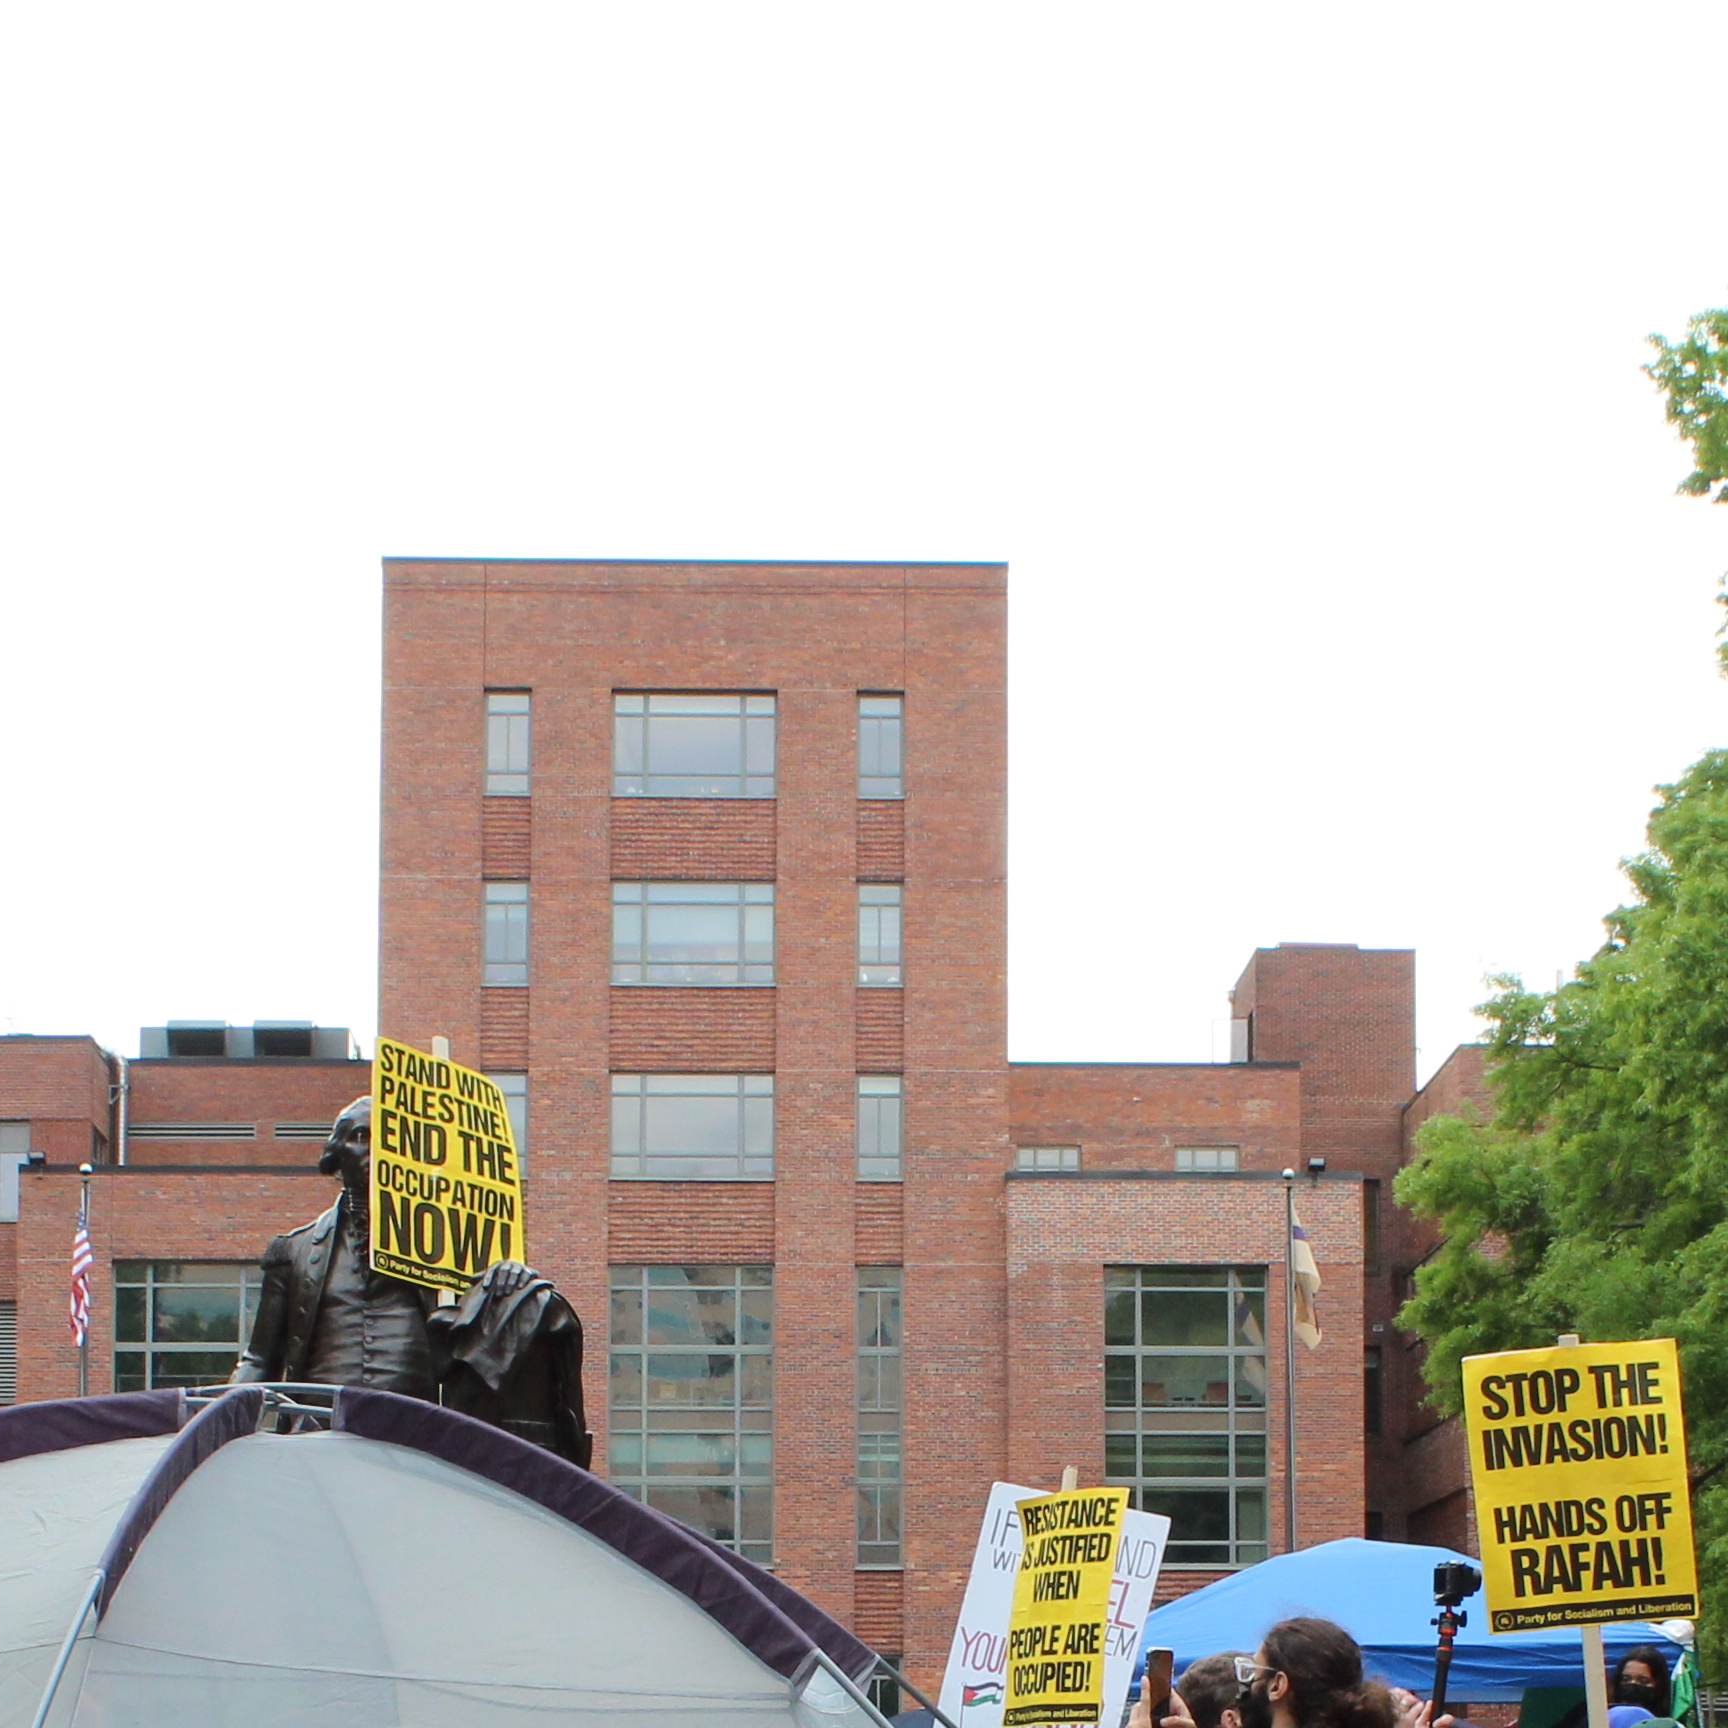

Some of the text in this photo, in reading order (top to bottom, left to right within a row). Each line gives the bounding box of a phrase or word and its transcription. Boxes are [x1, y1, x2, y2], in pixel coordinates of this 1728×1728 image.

[380, 1043, 505, 1115] STAND WITH
[380, 1074, 509, 1144] PALESTINE!
[380, 1107, 516, 1187] END THE
[377, 1159, 515, 1222] OCCUPATION
[1481, 1362, 1663, 1420] STOP THE
[1481, 1413, 1669, 1471] INVASION!
[990, 1508, 1019, 1548] IF
[1023, 1497, 1120, 1537] RESISTANCE
[1493, 1492, 1672, 1544] HANDS OFF
[1021, 1532, 1112, 1571] IS JUSTIFIED
[1510, 1537, 1666, 1598] RAFAH!
[1033, 1569, 1081, 1603] WHEN
[1516, 1614, 1545, 1625] Party
[1547, 1611, 1562, 1621] for
[1564, 1607, 1614, 1619] Socialism
[1616, 1604, 1636, 1615] and
[1638, 1602, 1692, 1614] Liberation
[1010, 1622, 1101, 1661] PEOPLE ARE
[1013, 1660, 1092, 1697] OCCUPIED!
[1064, 1708, 1096, 1718] Liberation
